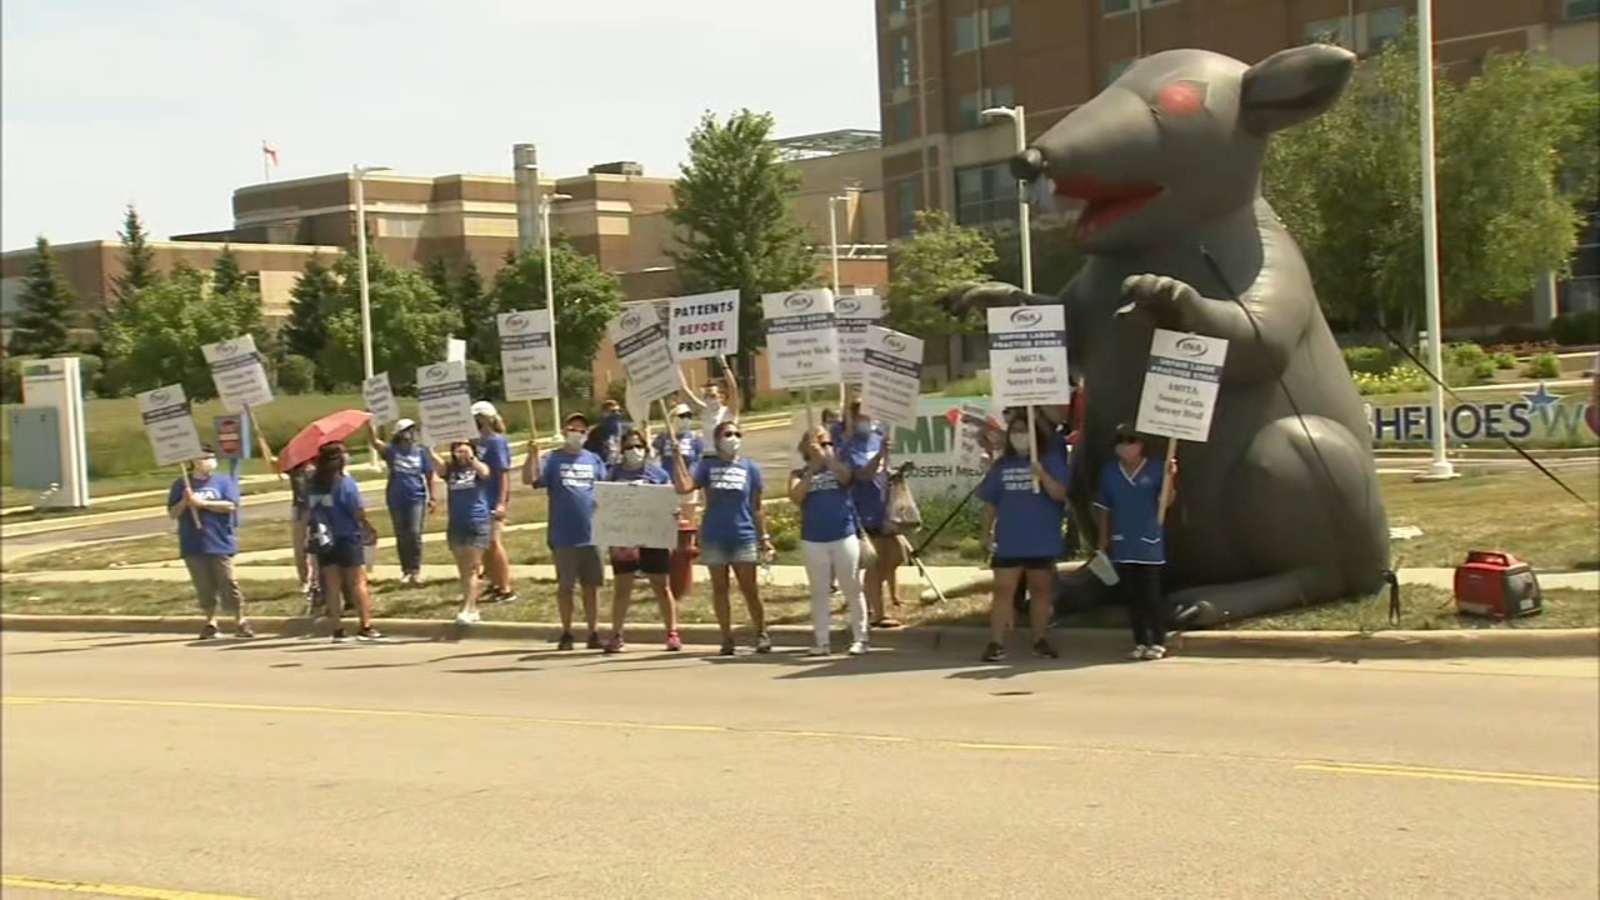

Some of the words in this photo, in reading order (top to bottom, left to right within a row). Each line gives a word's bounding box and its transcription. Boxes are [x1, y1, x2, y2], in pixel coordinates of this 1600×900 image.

[674, 301, 734, 318] PATIENTS
[679, 321, 725, 335] BEFORE
[677, 338, 727, 352] PROFIT!
[1375, 403, 1533, 440] HEOES
